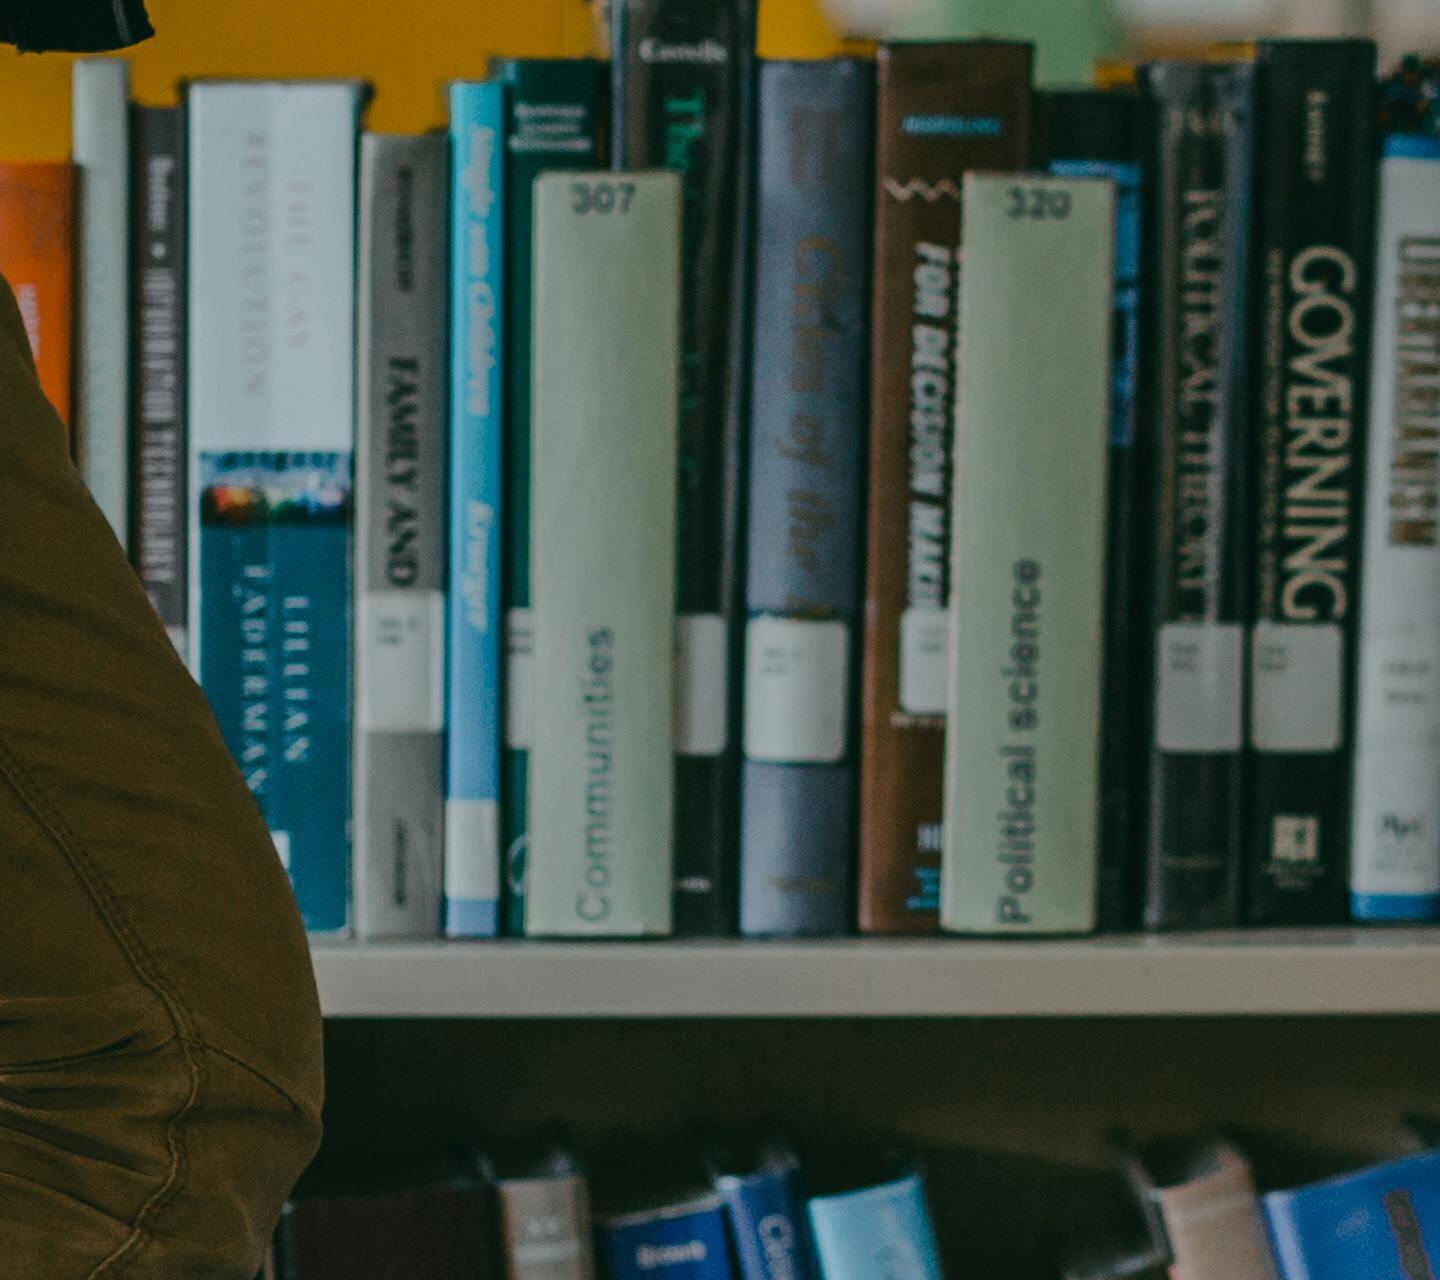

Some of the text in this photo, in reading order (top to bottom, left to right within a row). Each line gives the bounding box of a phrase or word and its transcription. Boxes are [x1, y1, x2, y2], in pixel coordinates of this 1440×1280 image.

[570, 182, 636, 216] 307
[1006, 187, 1073, 220] 320
[384, 356, 421, 588] FAMILY AND
[910, 242, 951, 497] FOR DECISION
[1282, 244, 1358, 620] GOVERNING
[574, 627, 614, 924] Communities
[996, 557, 1042, 926] Political science
